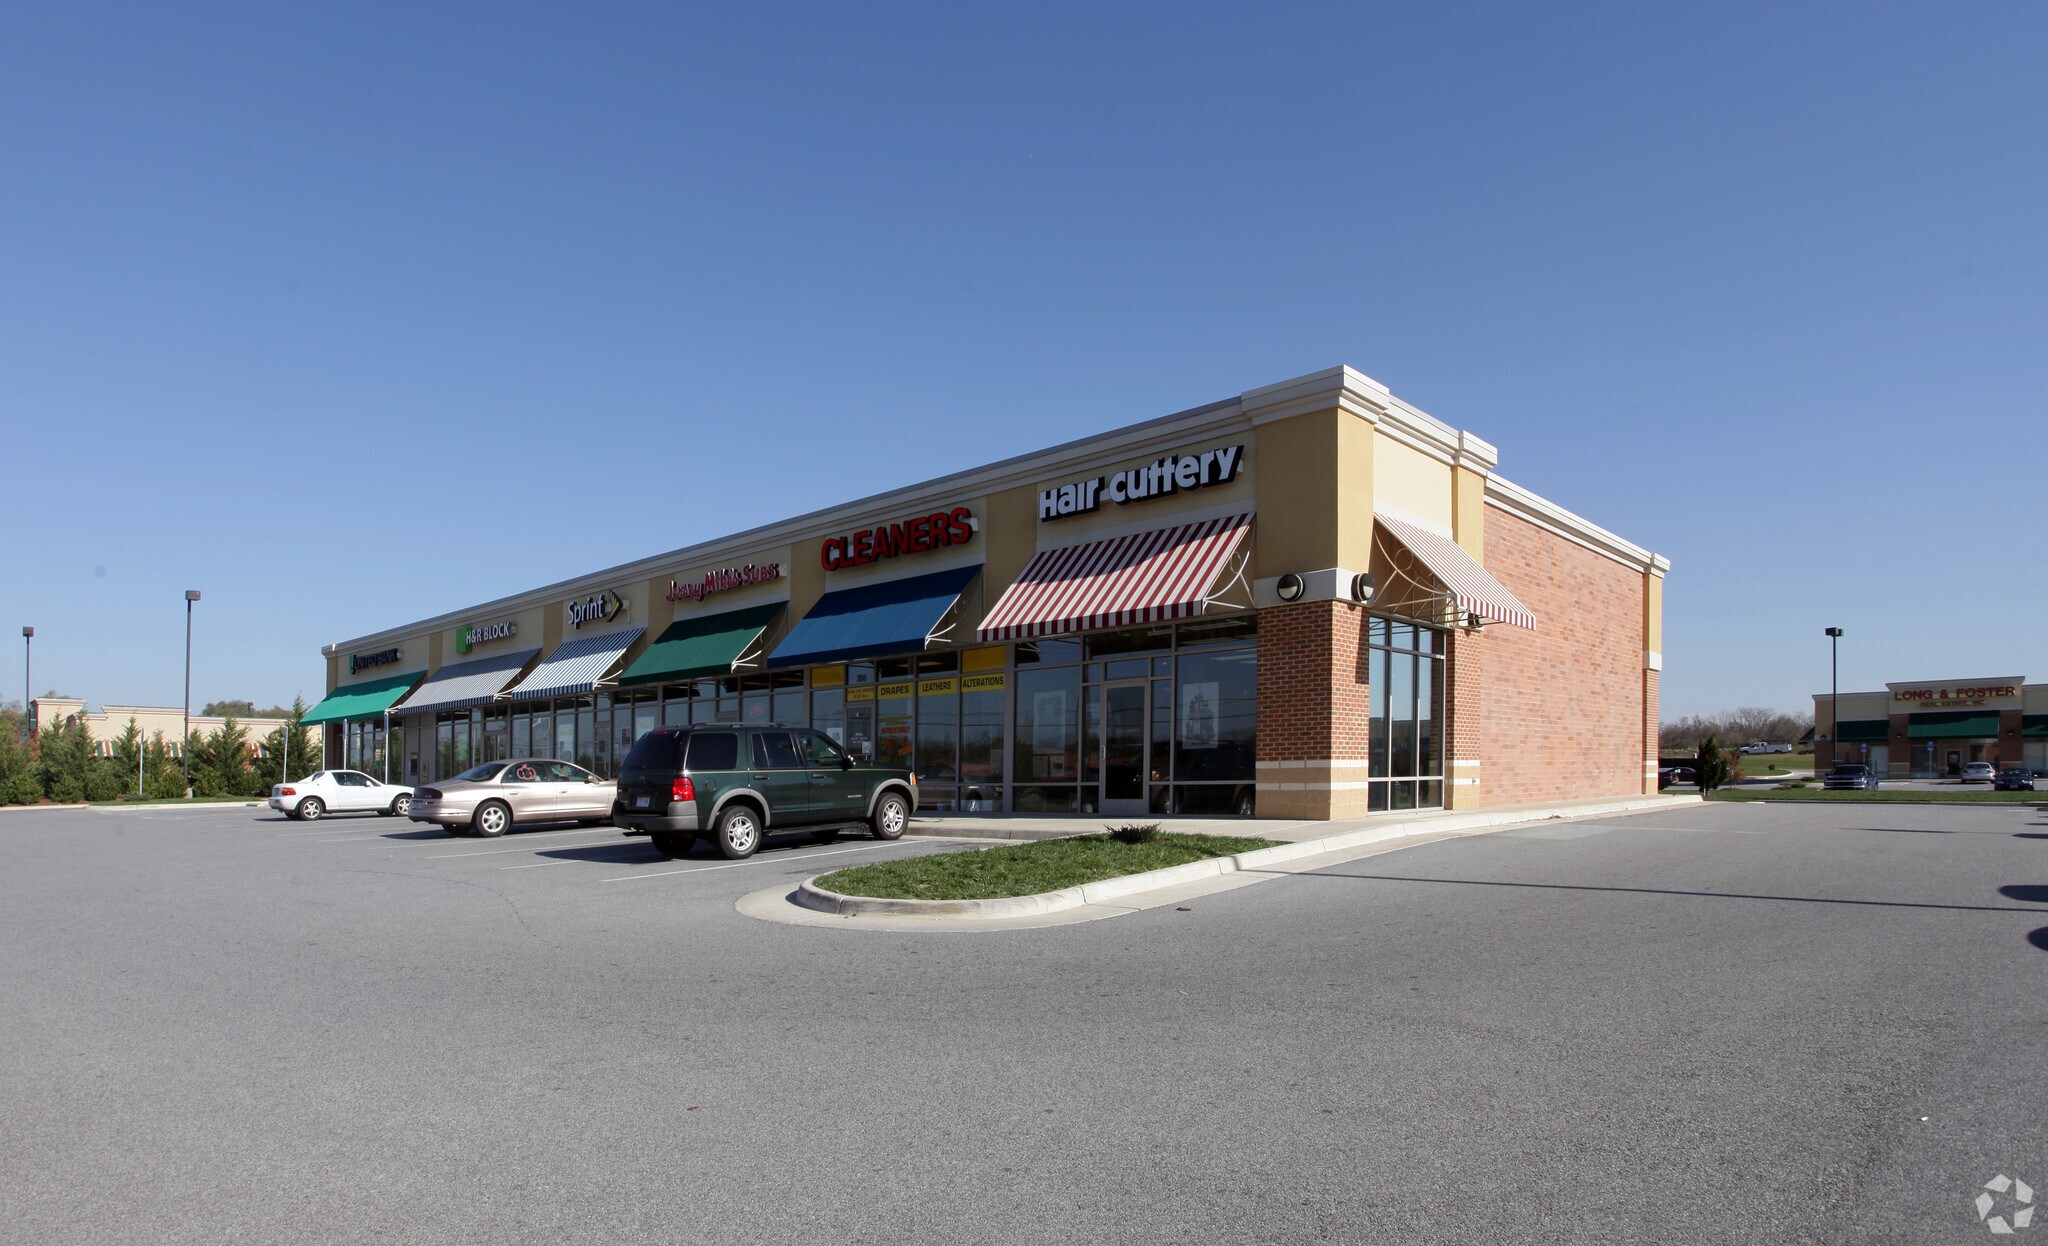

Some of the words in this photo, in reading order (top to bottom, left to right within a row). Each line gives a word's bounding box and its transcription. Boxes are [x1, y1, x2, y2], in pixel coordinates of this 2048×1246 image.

[1039, 477, 1103, 521] Hair
[821, 507, 972, 571] CLEANERS
[666, 580, 705, 601] Jersey
[704, 568, 740, 592] Mike's
[568, 594, 605, 629] Sprint
[466, 629, 482, 645] H&R
[483, 622, 511, 640] BLOCK
[880, 684, 909, 696] DRAPES
[922, 681, 951, 692] LEATHERS
[962, 675, 1004, 689] ALTERATIONS
[1894, 689, 1933, 701] LONG
[1939, 689, 1949, 699] &
[1956, 686, 2015, 698] FOSTER
